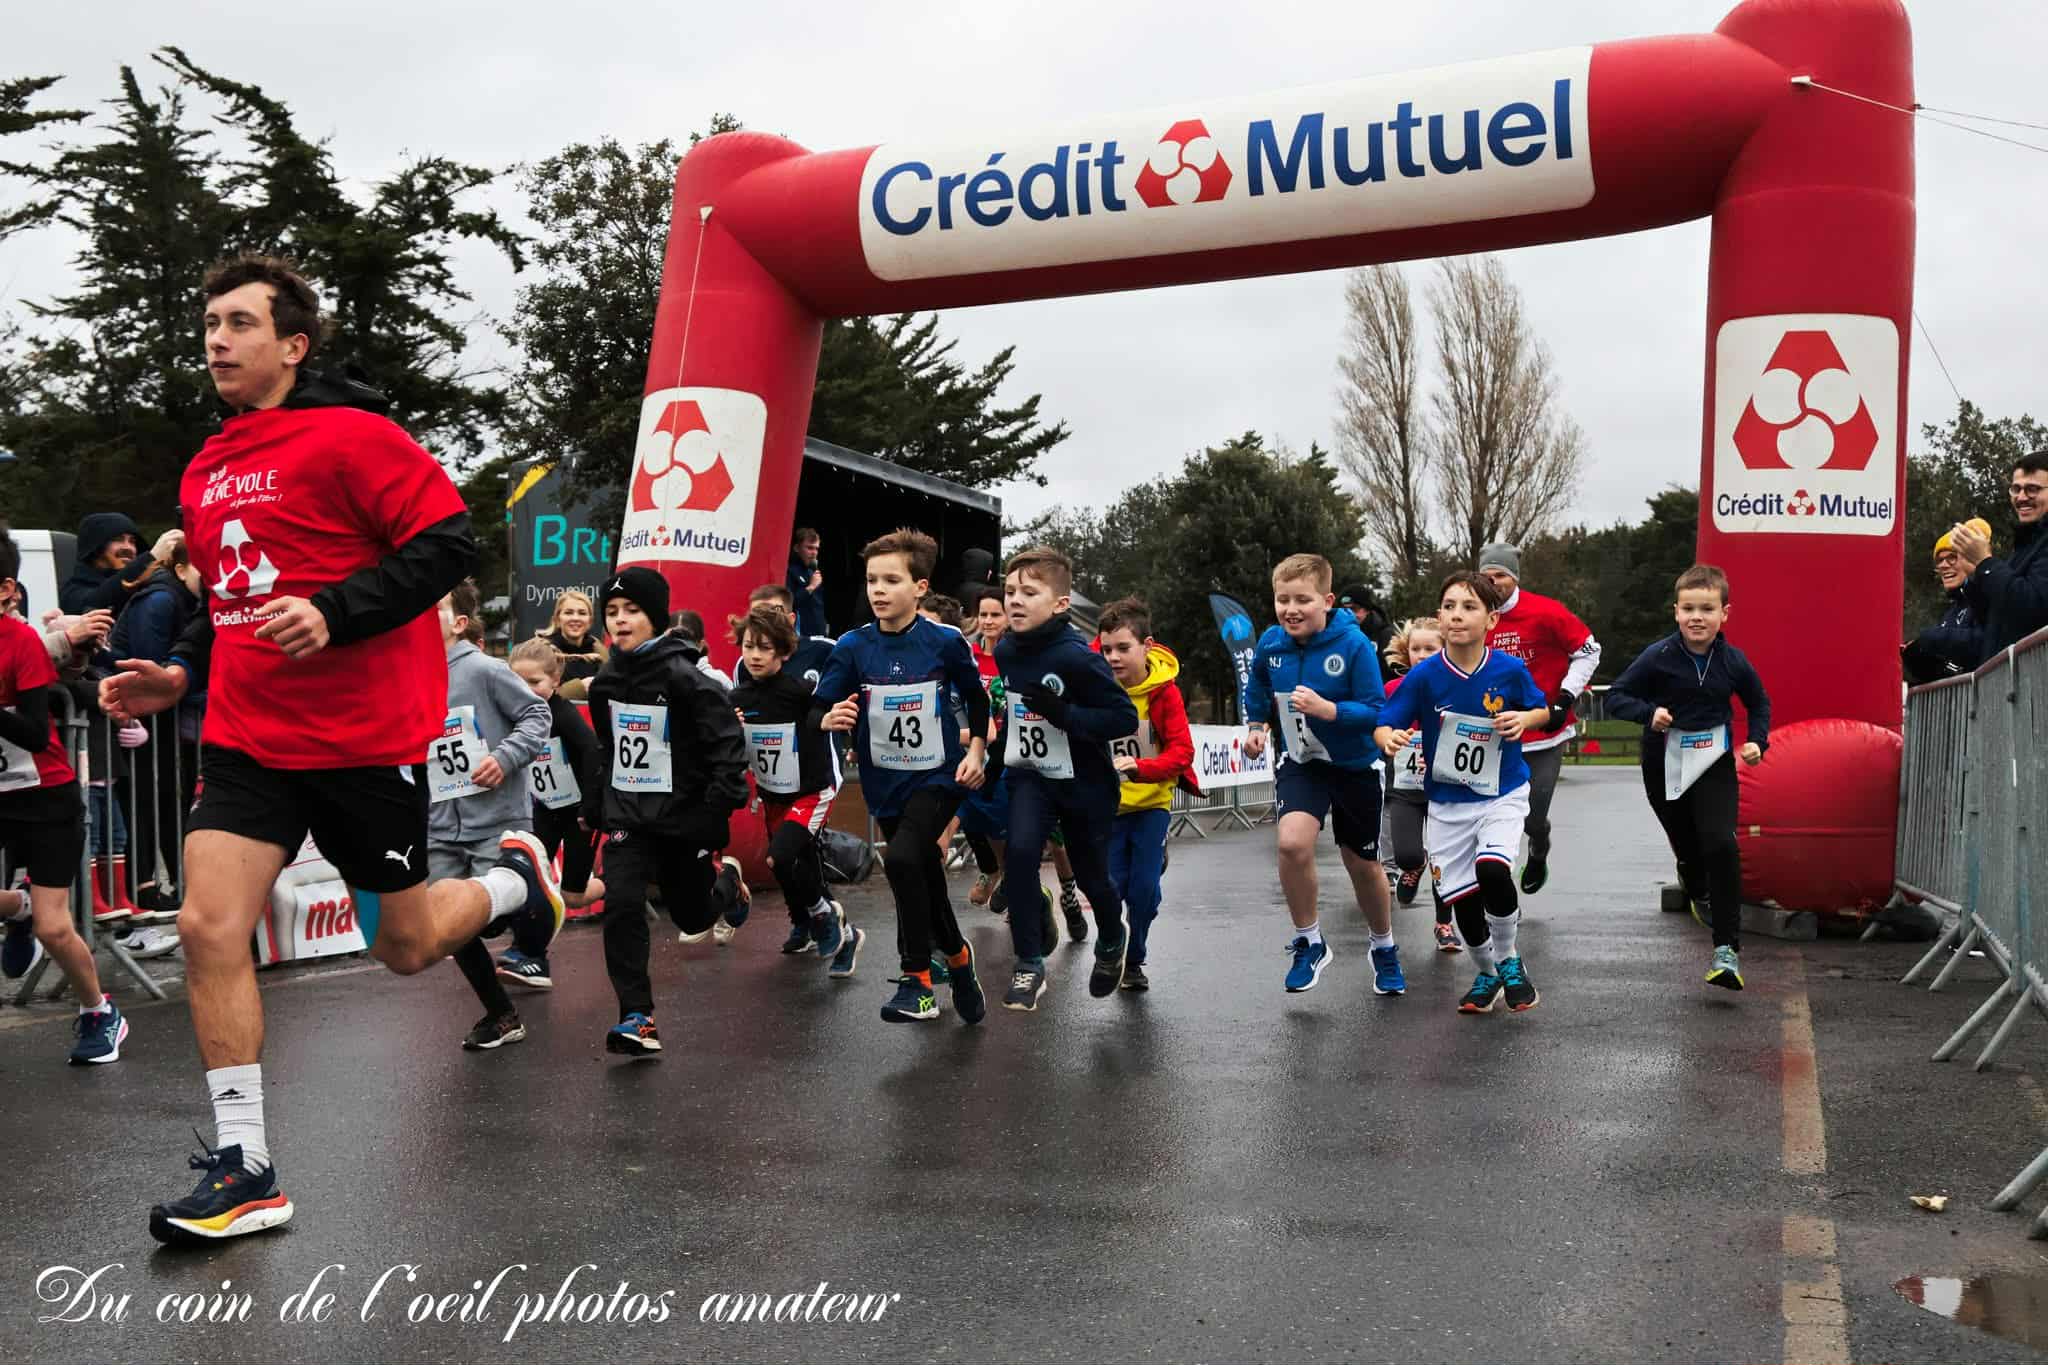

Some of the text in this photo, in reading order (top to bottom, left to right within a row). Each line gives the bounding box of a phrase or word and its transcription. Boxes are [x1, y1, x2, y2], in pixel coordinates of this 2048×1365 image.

[871, 78, 1573, 236] Crédit Mutuel
[1717, 493, 1892, 519] Crédit Mutuel
[673, 529, 746, 555] Mutuel
[888, 716, 923, 748] 43
[1019, 725, 1048, 758] 58
[437, 740, 469, 775] 55
[619, 735, 650, 769] 62
[757, 749, 780, 775] 57
[1203, 742, 1230, 776] Crédit
[1454, 742, 1485, 775] 60
[532, 764, 557, 793] 81
[305, 897, 353, 941] ma
